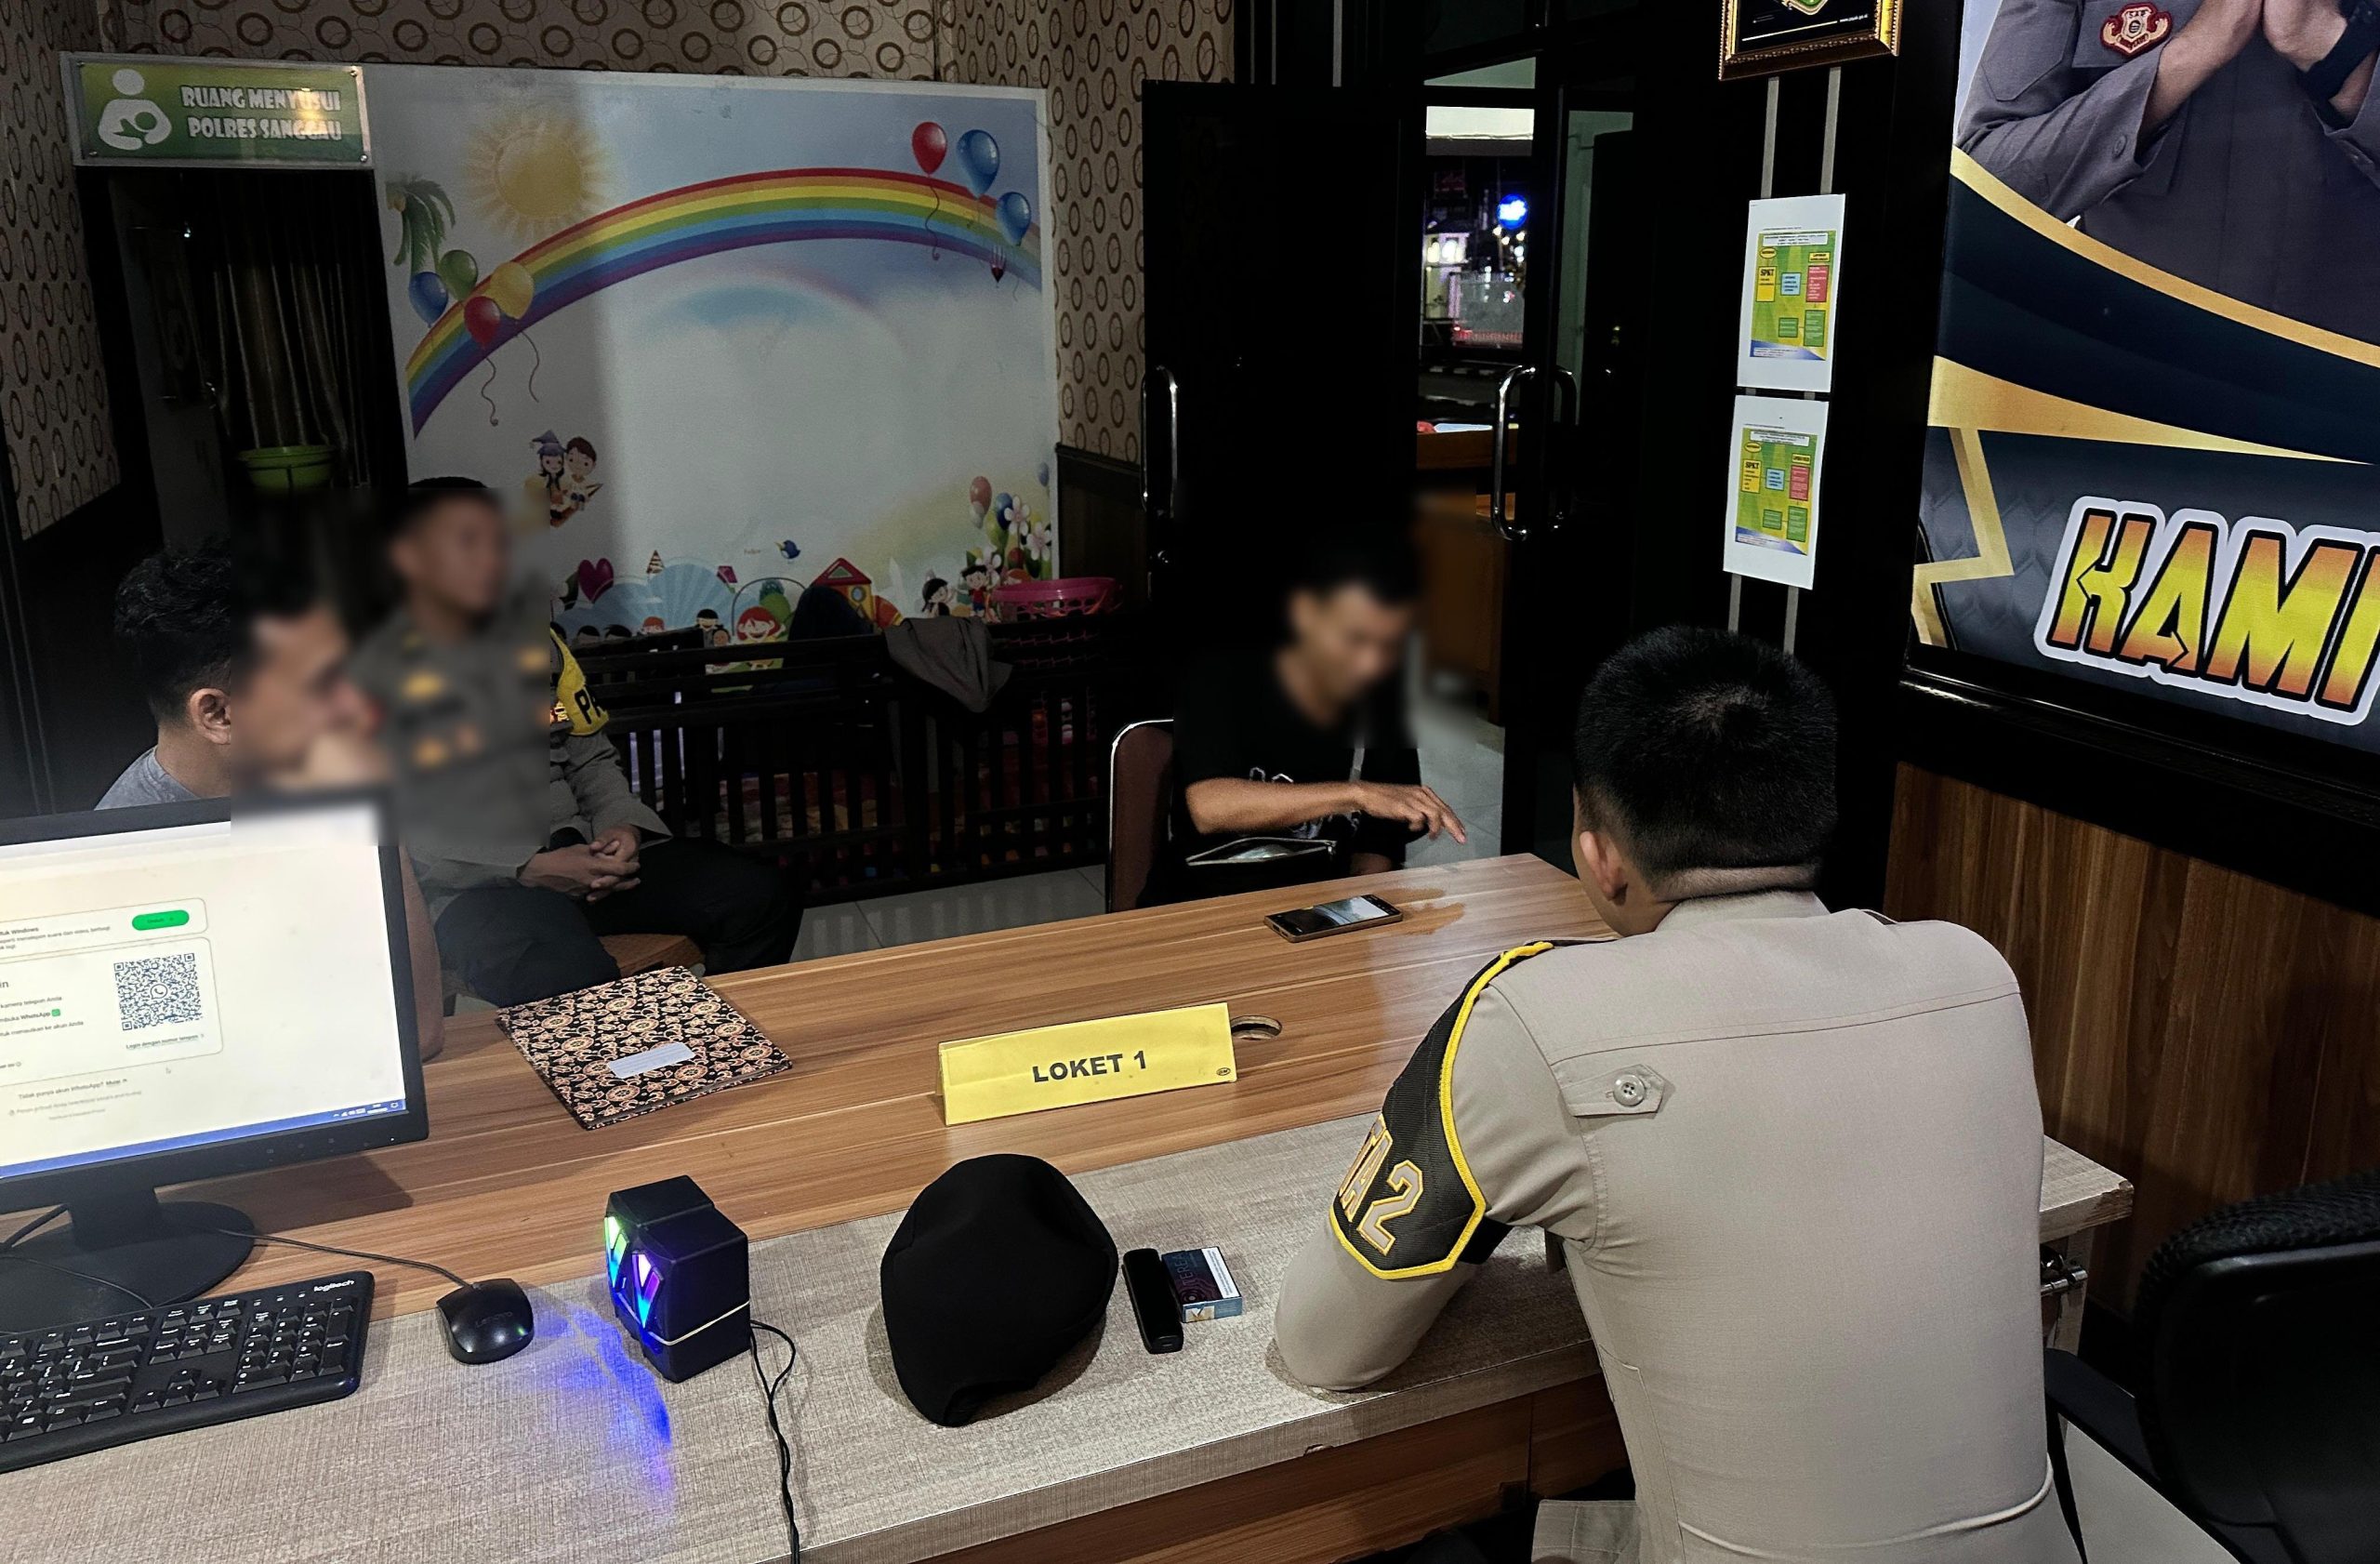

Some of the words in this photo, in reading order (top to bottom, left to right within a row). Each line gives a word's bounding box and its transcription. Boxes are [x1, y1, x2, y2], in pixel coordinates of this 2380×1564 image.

[181, 86, 245, 110] RUANG
[188, 116, 257, 139] POLRES
[2045, 507, 2380, 713] KAMI
[1033, 1054, 1123, 1083] LOKET
[1133, 1051, 1147, 1070] 1
